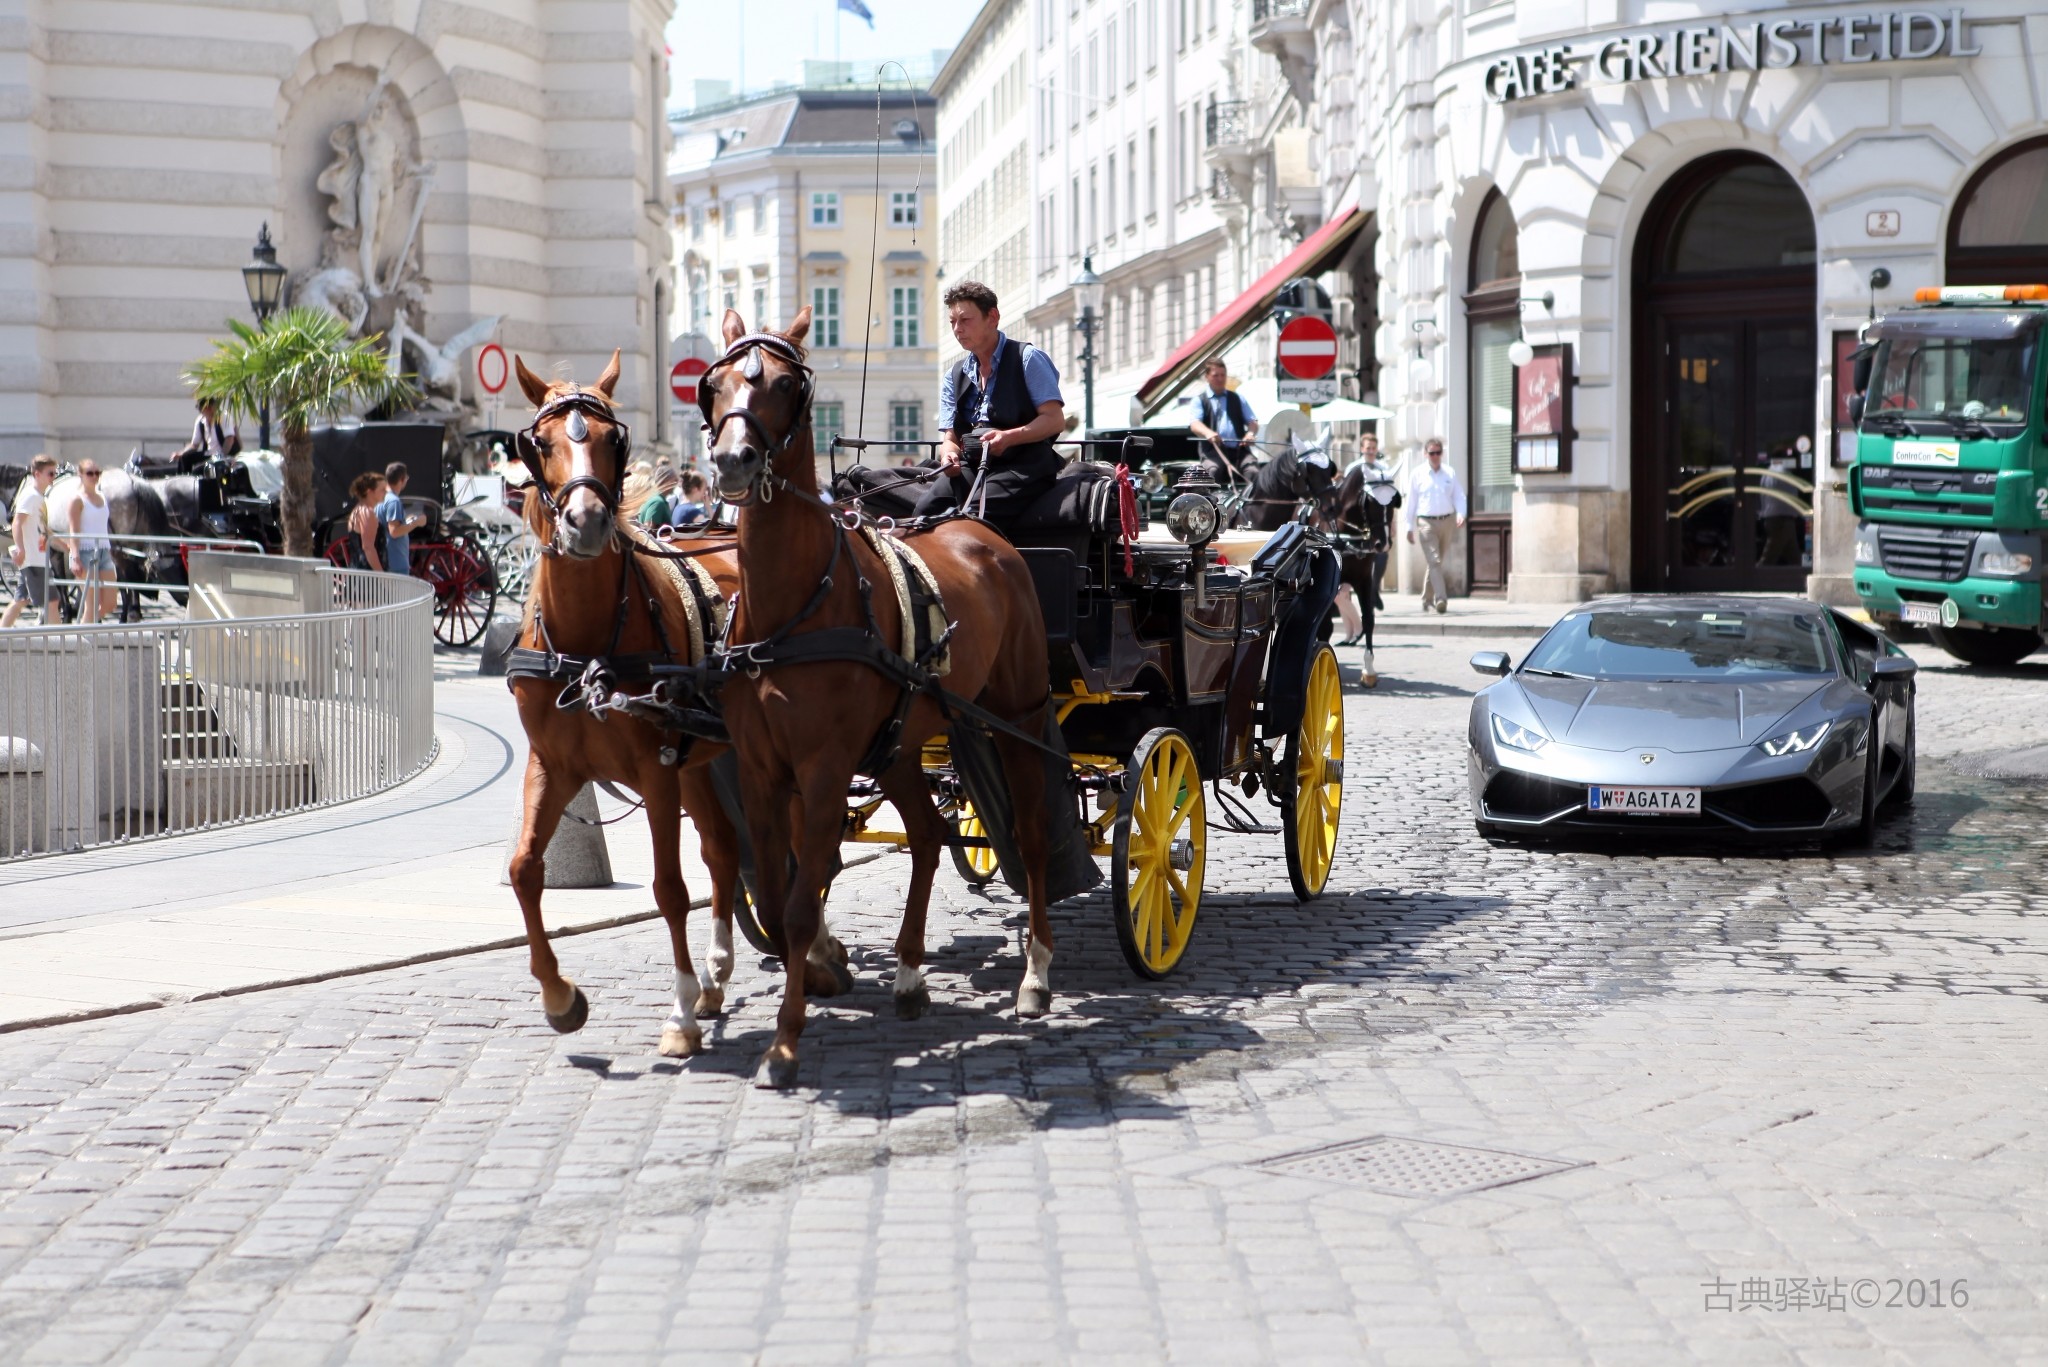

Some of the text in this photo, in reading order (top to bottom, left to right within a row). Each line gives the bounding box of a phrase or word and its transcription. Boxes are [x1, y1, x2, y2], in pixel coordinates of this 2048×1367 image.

[1590, 8, 1982, 84] GRIENSTEIDL
[1879, 212, 1888, 228] 2
[1863, 467, 1890, 478] DAF
[1973, 472, 1997, 485] CF
[1945, 603, 1955, 622] L
[1601, 791, 1613, 806] W
